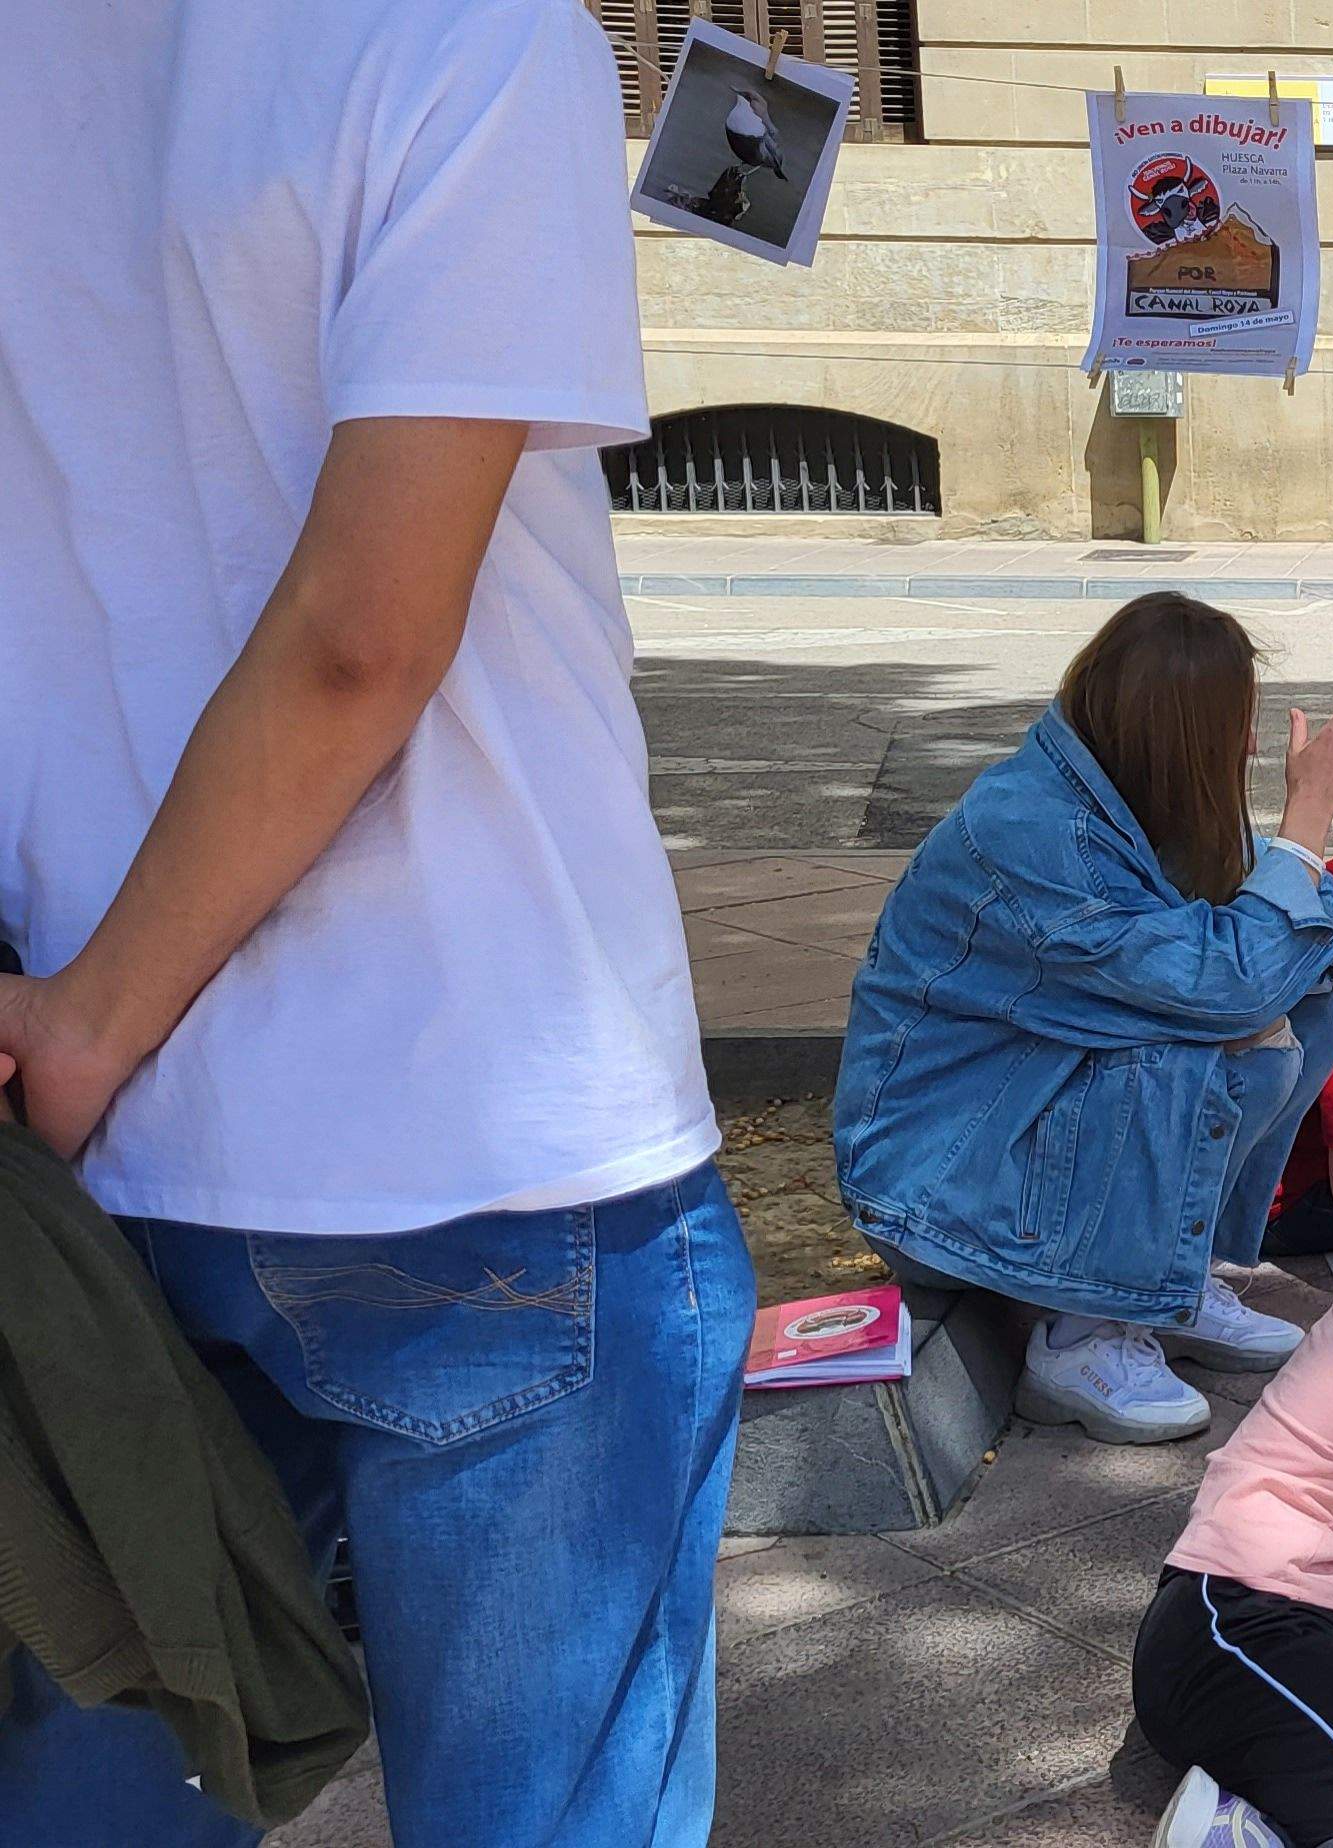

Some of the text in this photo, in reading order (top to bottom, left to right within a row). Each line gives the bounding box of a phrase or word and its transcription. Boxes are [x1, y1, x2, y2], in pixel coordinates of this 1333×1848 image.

[1170, 119, 1184, 133] a
[1189, 114, 1288, 150] dibujar!
[1221, 152, 1265, 164] HUESCA
[1222, 164, 1288, 177] Plaza Navarra
[1177, 266, 1217, 282] POR
[1134, 294, 1261, 315] CANAL ROYA
[1197, 314, 1290, 335] Domingo 14 de mayo
[1135, 338, 1217, 350] esperamos!
